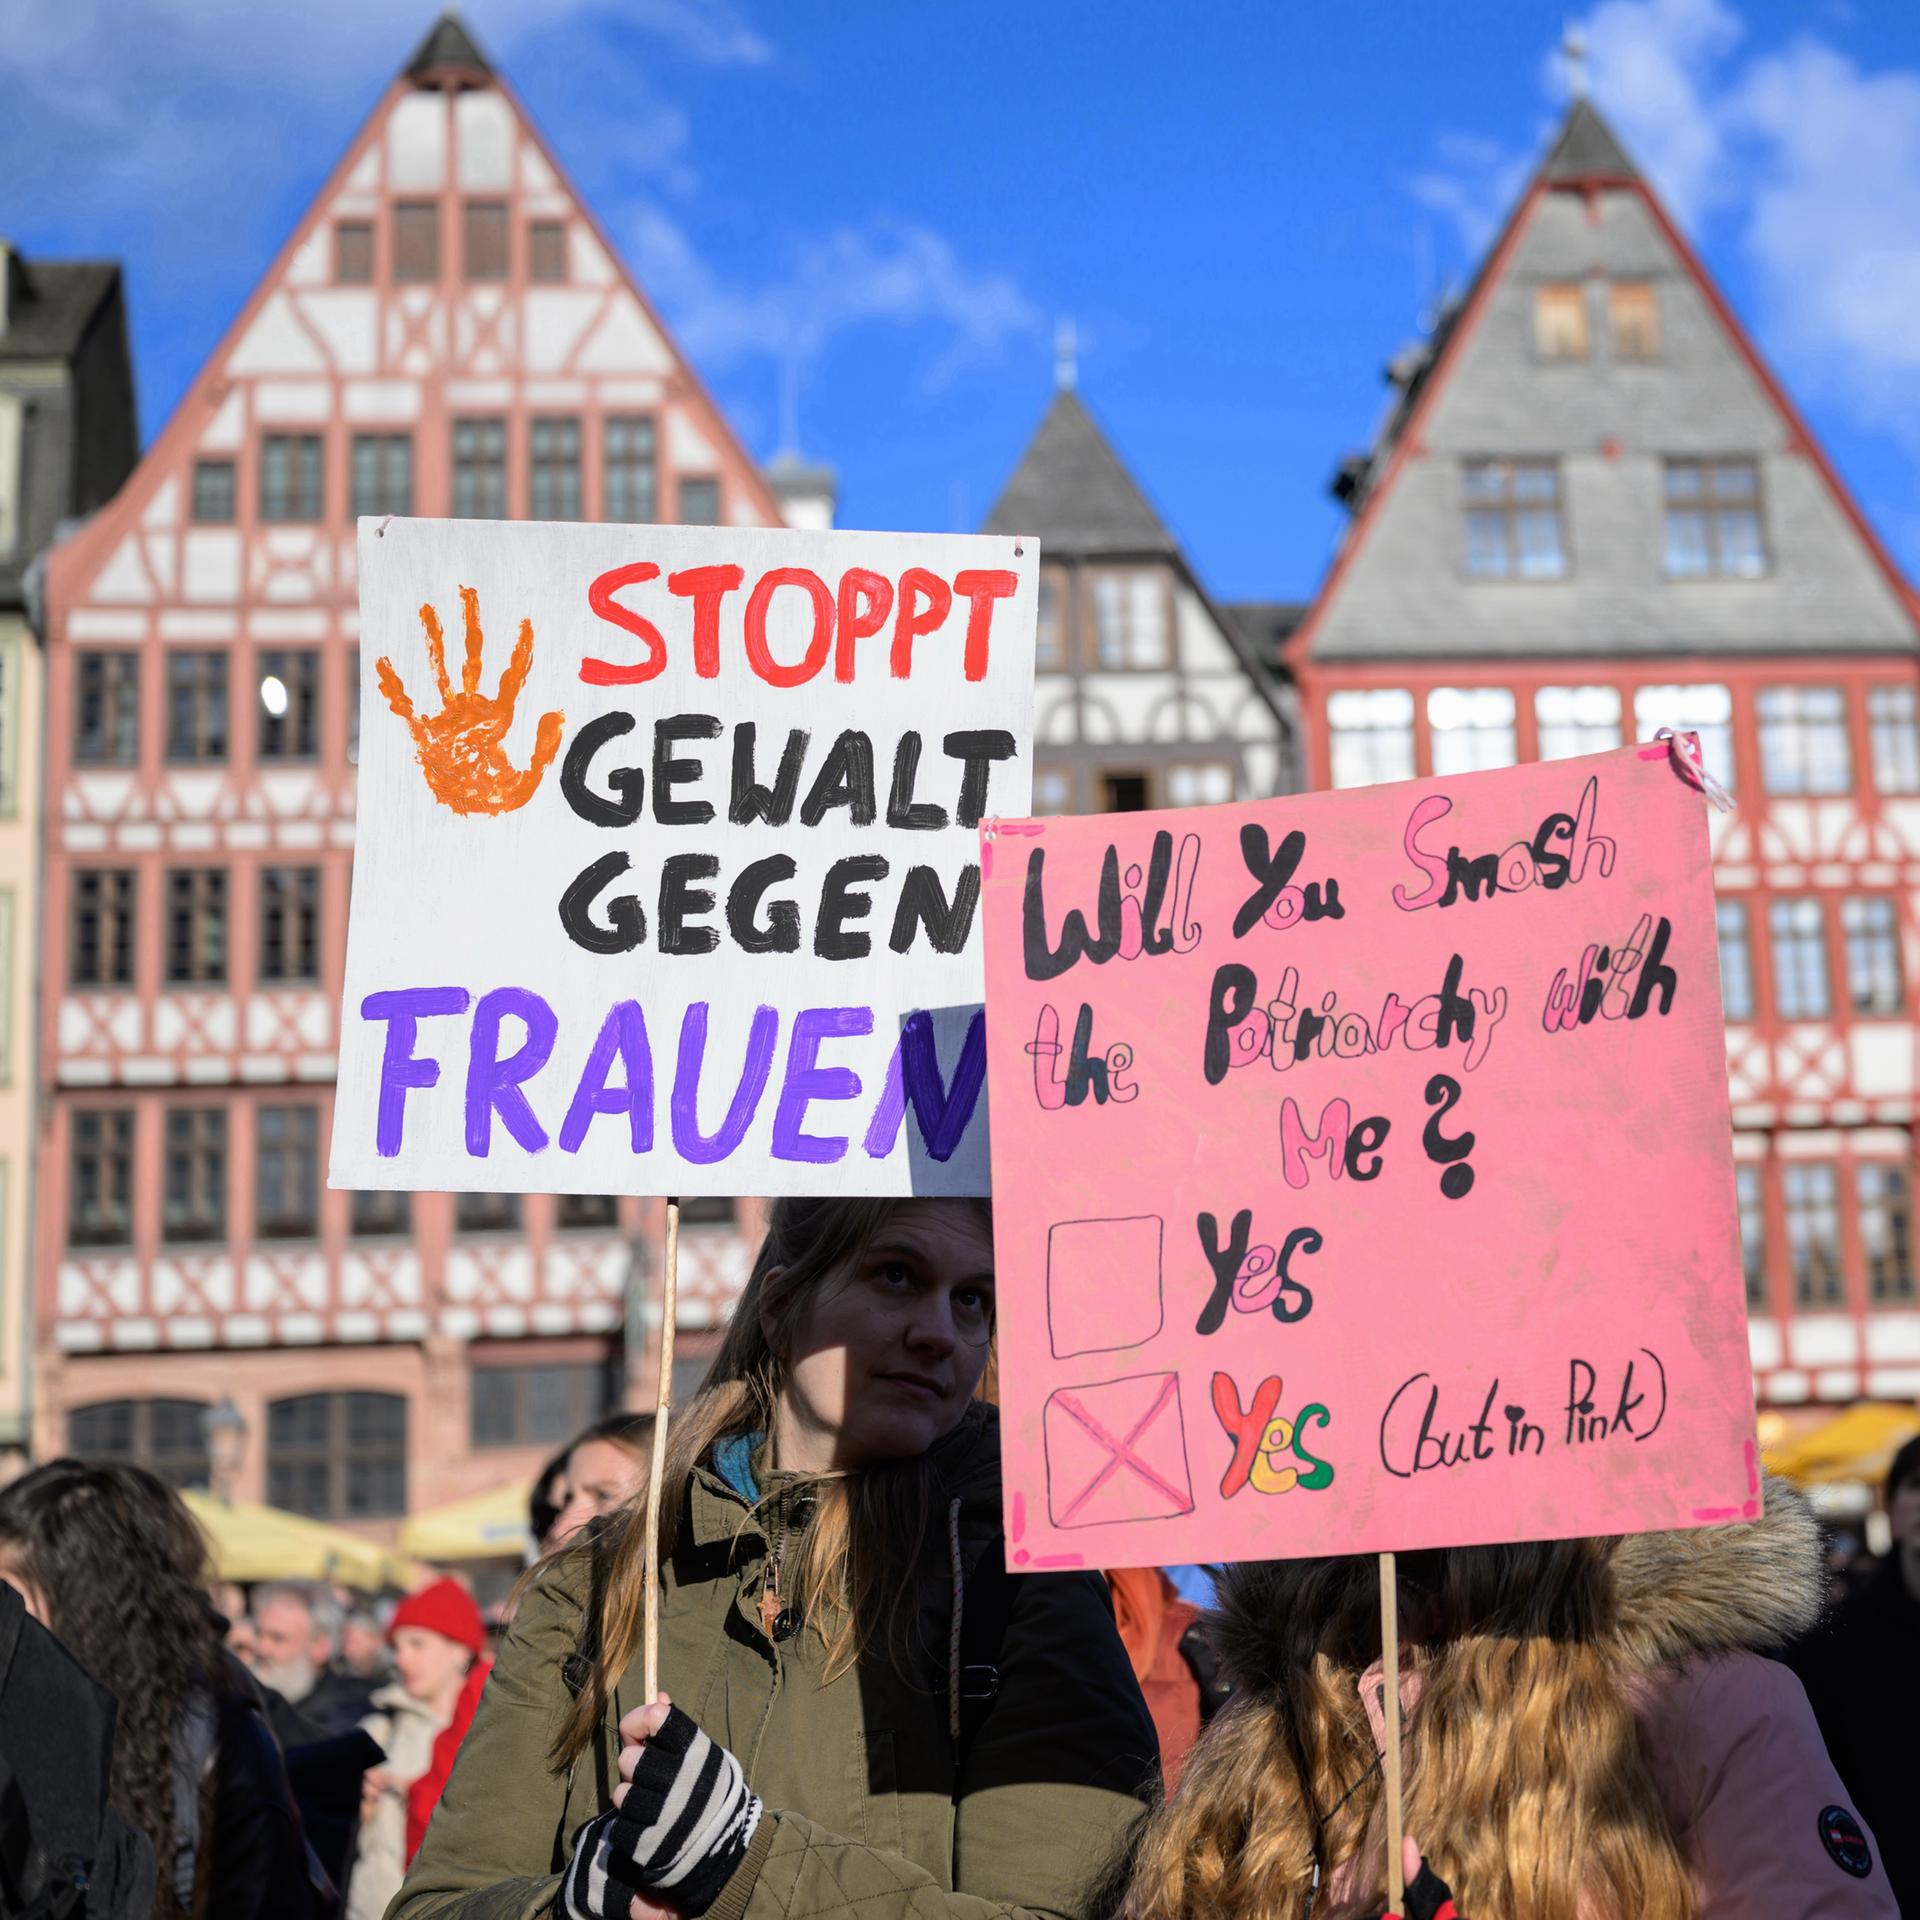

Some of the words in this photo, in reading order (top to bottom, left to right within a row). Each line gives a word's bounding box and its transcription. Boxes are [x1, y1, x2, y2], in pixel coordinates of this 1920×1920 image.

[579, 562, 1019, 688] STOPPT
[560, 711, 1018, 831] GEWALT
[559, 851, 981, 960] GEGEN
[1022, 830, 1201, 981] Will
[1233, 824, 1345, 938] You
[1392, 776, 1616, 912] Smash
[361, 986, 988, 1164] FRAUEN
[1025, 1003, 1139, 1111] the
[1204, 954, 1507, 1085] Patriarchy
[1195, 1208, 1323, 1335] Yes
[1211, 1371, 1334, 1499] Yes
[1380, 1373, 1498, 1478] (but
[1504, 1405, 1545, 1456] in
